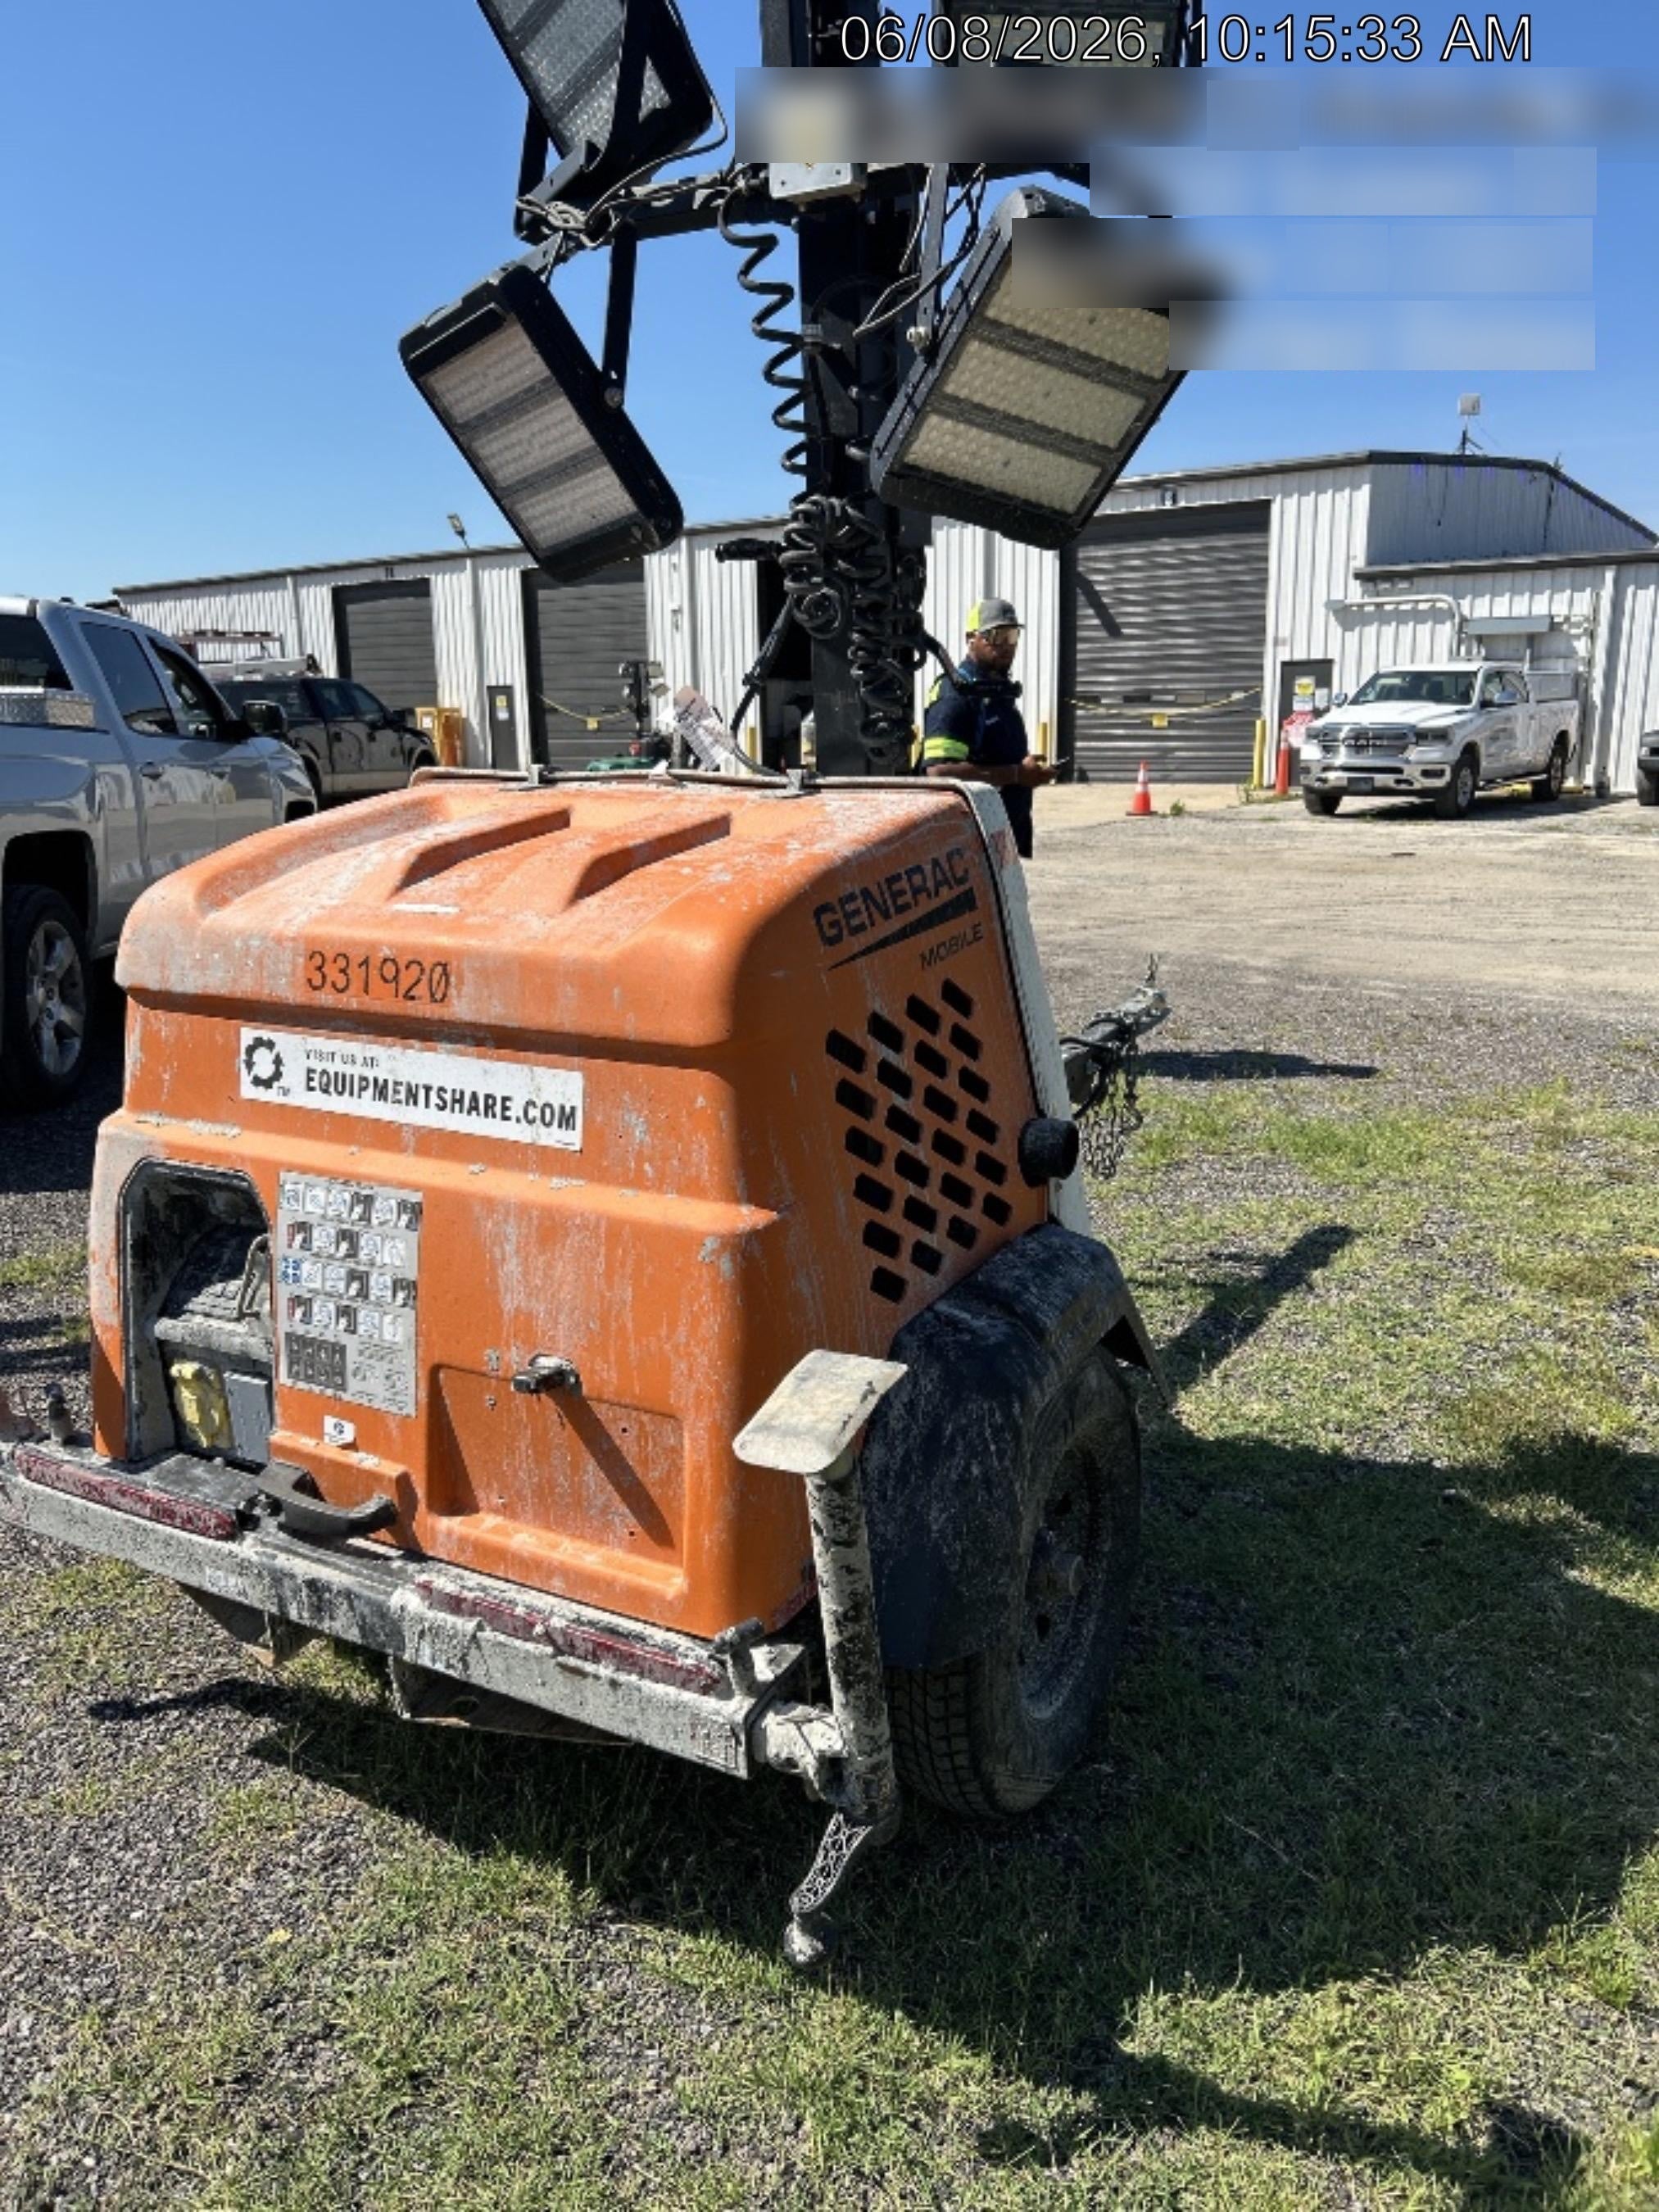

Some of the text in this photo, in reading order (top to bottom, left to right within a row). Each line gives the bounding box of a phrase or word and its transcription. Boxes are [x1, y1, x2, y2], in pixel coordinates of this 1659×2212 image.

[813, 847, 970, 947] GENERAC
[918, 921, 984, 971] MOBILE
[306, 950, 450, 1003] 331920
[305, 1049, 379, 1069] VISIT US AT:
[306, 1067, 578, 1131] EQUIPMENTSHARE.COM
